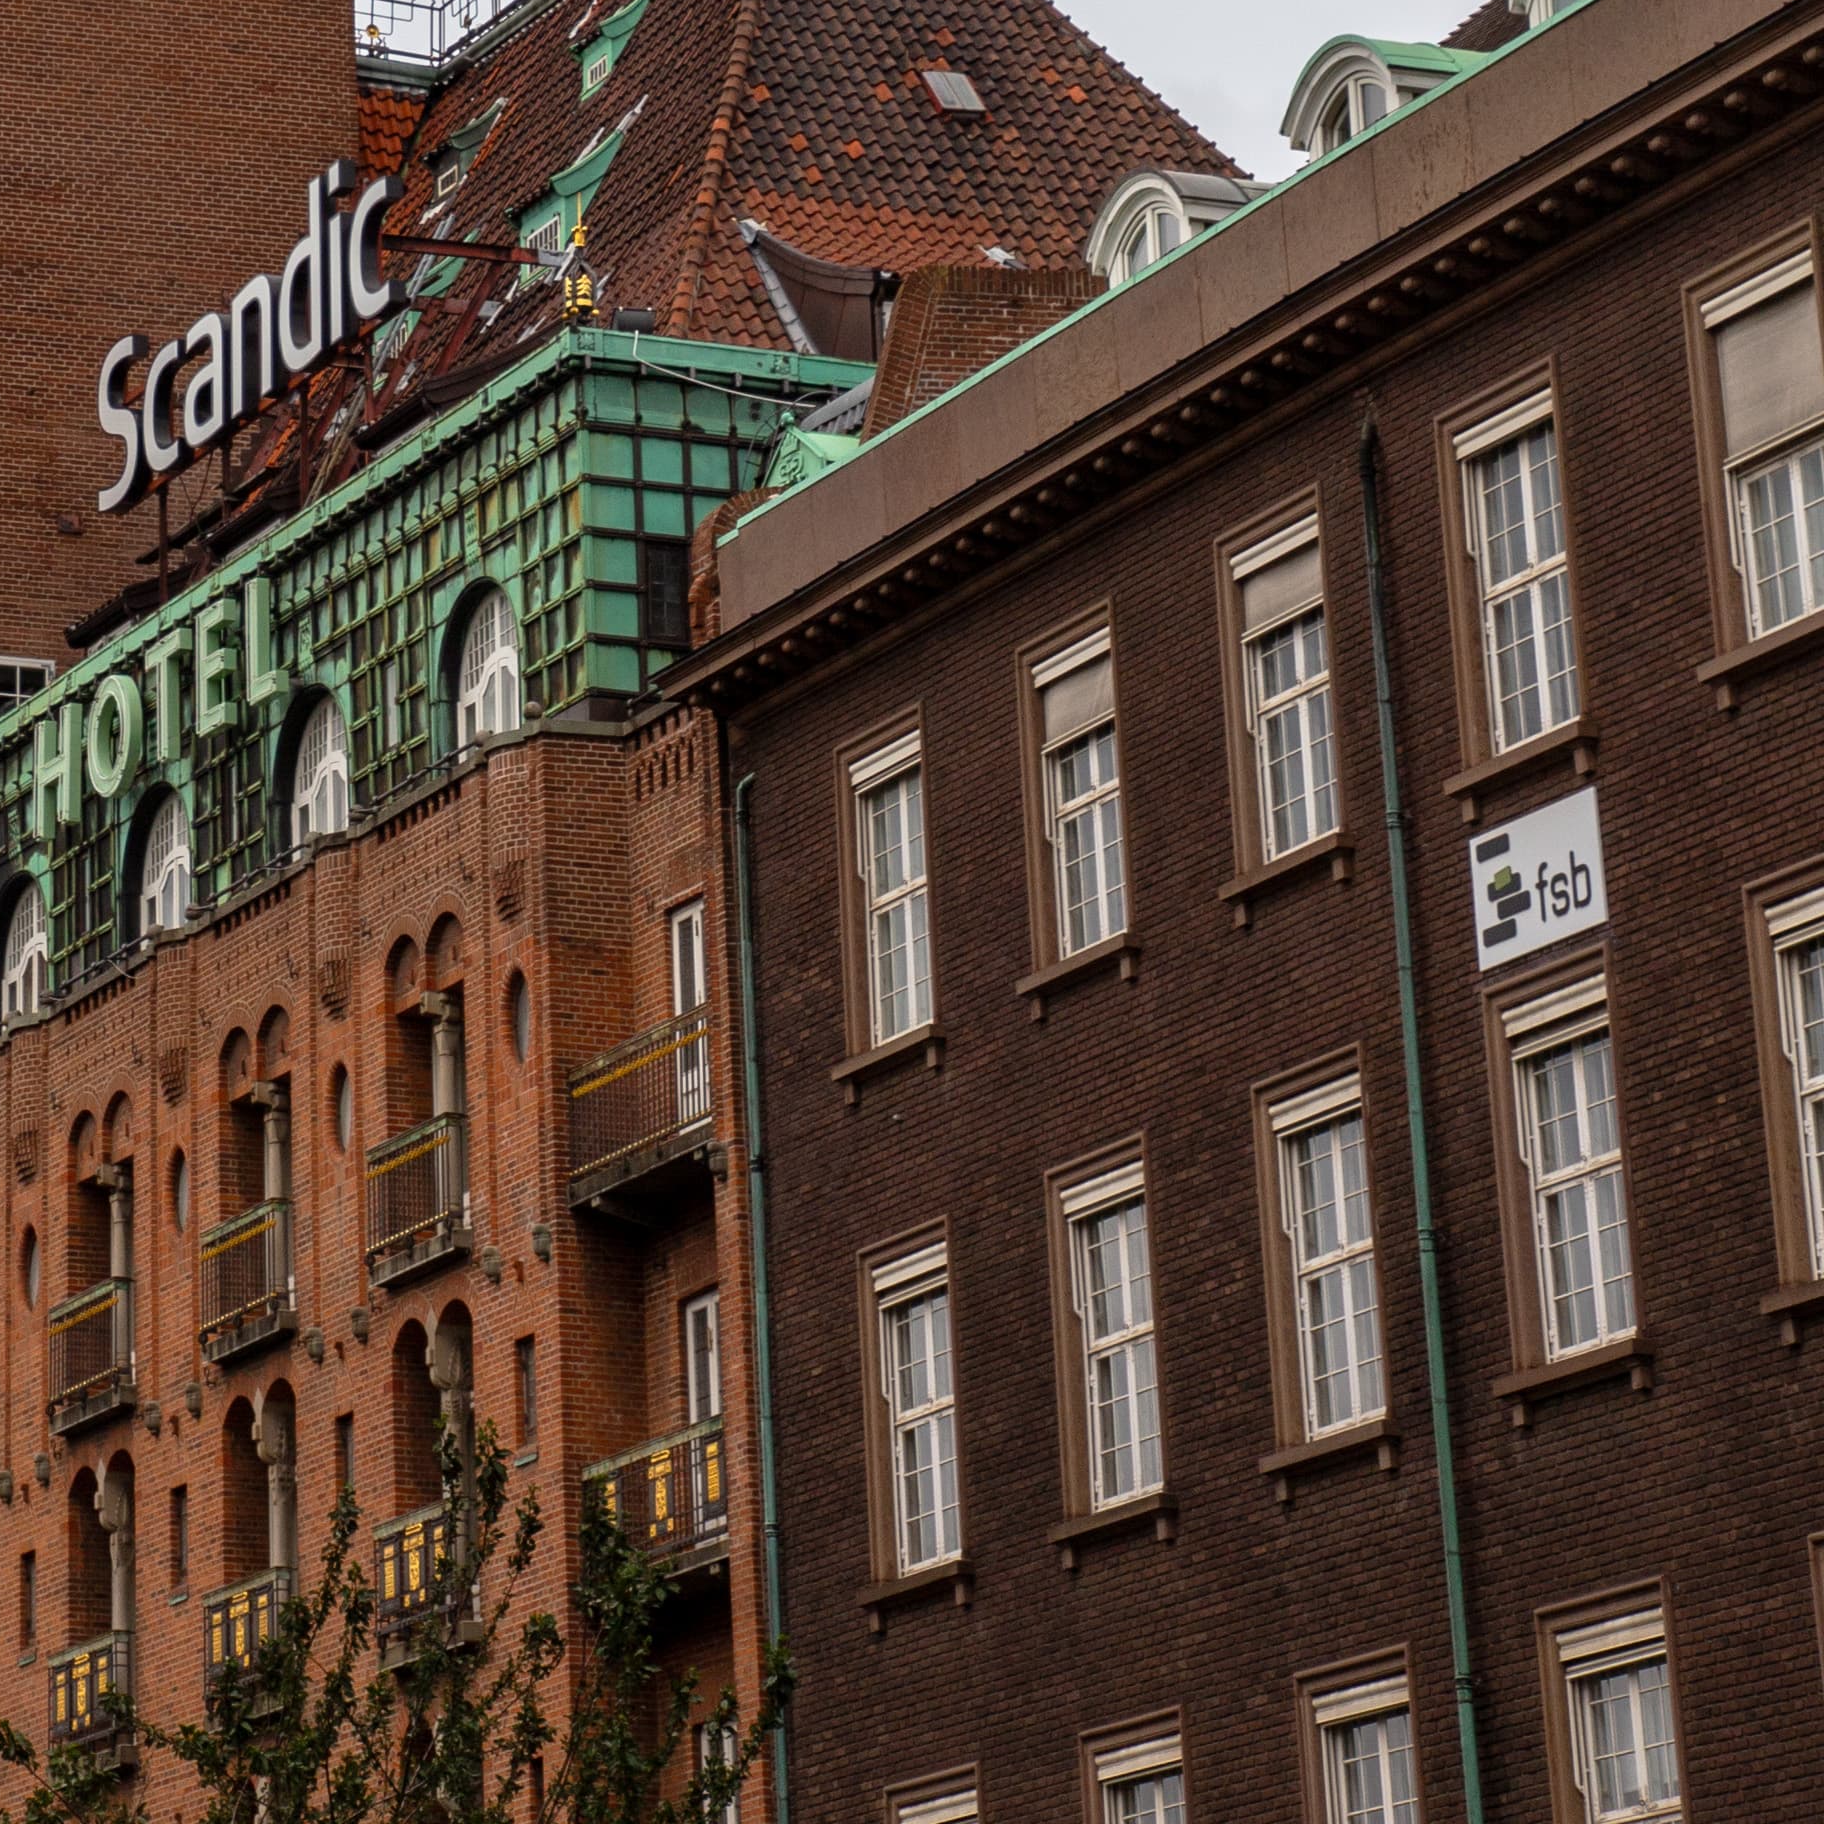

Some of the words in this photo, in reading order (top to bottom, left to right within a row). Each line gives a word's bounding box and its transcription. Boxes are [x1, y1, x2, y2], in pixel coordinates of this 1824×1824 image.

[98, 159, 406, 513] Scandic
[33, 577, 289, 841] HOTEL
[1535, 850, 1592, 923] fsb
